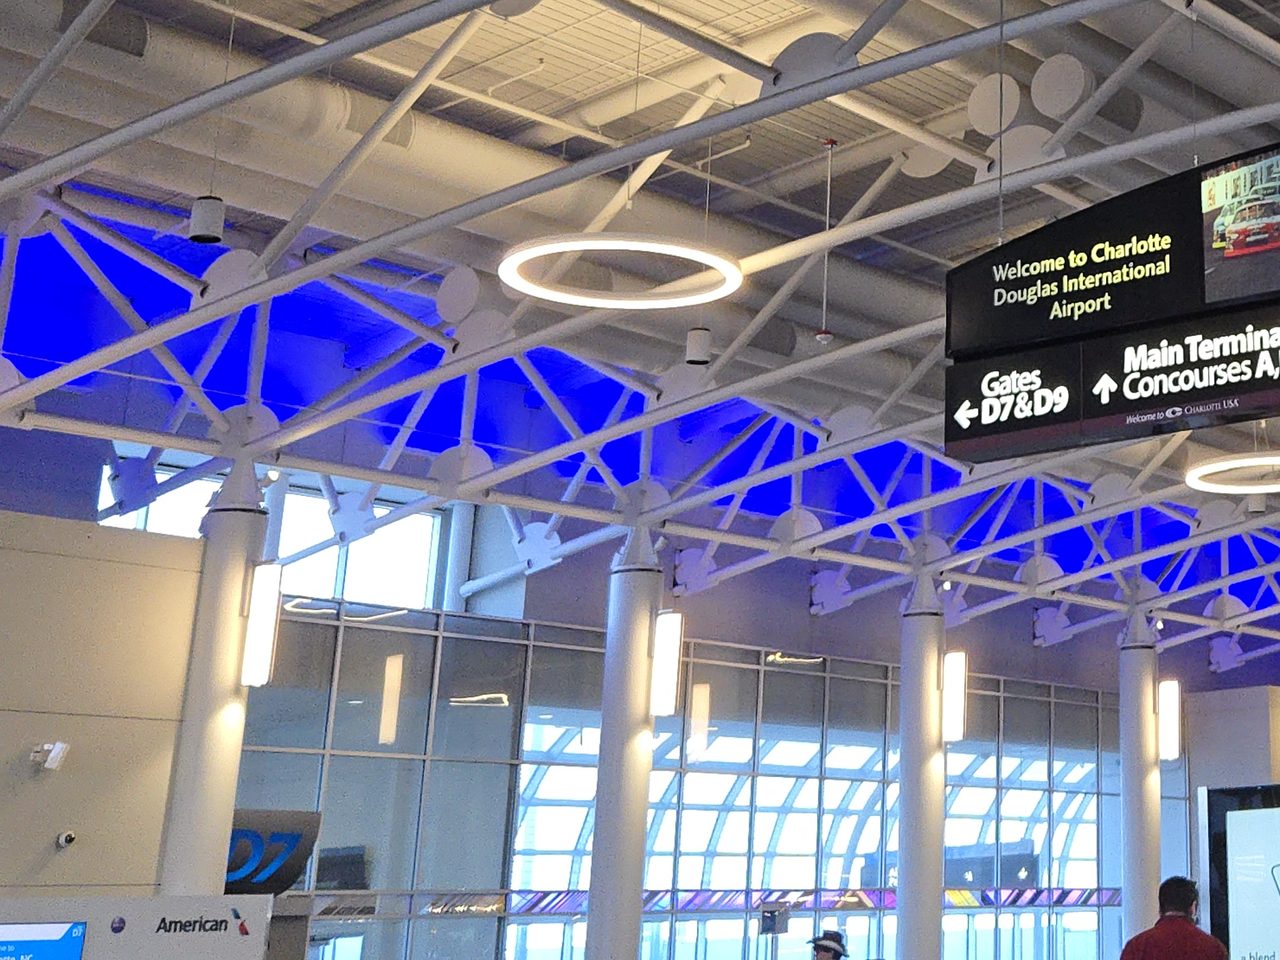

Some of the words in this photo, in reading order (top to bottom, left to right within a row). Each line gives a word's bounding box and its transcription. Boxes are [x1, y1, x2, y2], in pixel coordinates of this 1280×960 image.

[993, 256, 1065, 282] Welcome
[1068, 250, 1088, 268] to
[1091, 233, 1172, 263] Charlotte
[993, 280, 1058, 306] Douglas
[1062, 254, 1171, 293] International
[1049, 292, 1112, 320] Airport
[1123, 339, 1184, 374] Main
[981, 369, 1042, 397] Gates
[1123, 359, 1252, 400] Concourses
[1126, 412, 1155, 425] Welcome
[1156, 411, 1165, 420] to
[1185, 402, 1222, 416] CHARLOTTE
[1223, 398, 1239, 410] USA
[225, 827, 303, 884] D7
[156, 915, 229, 934] American
